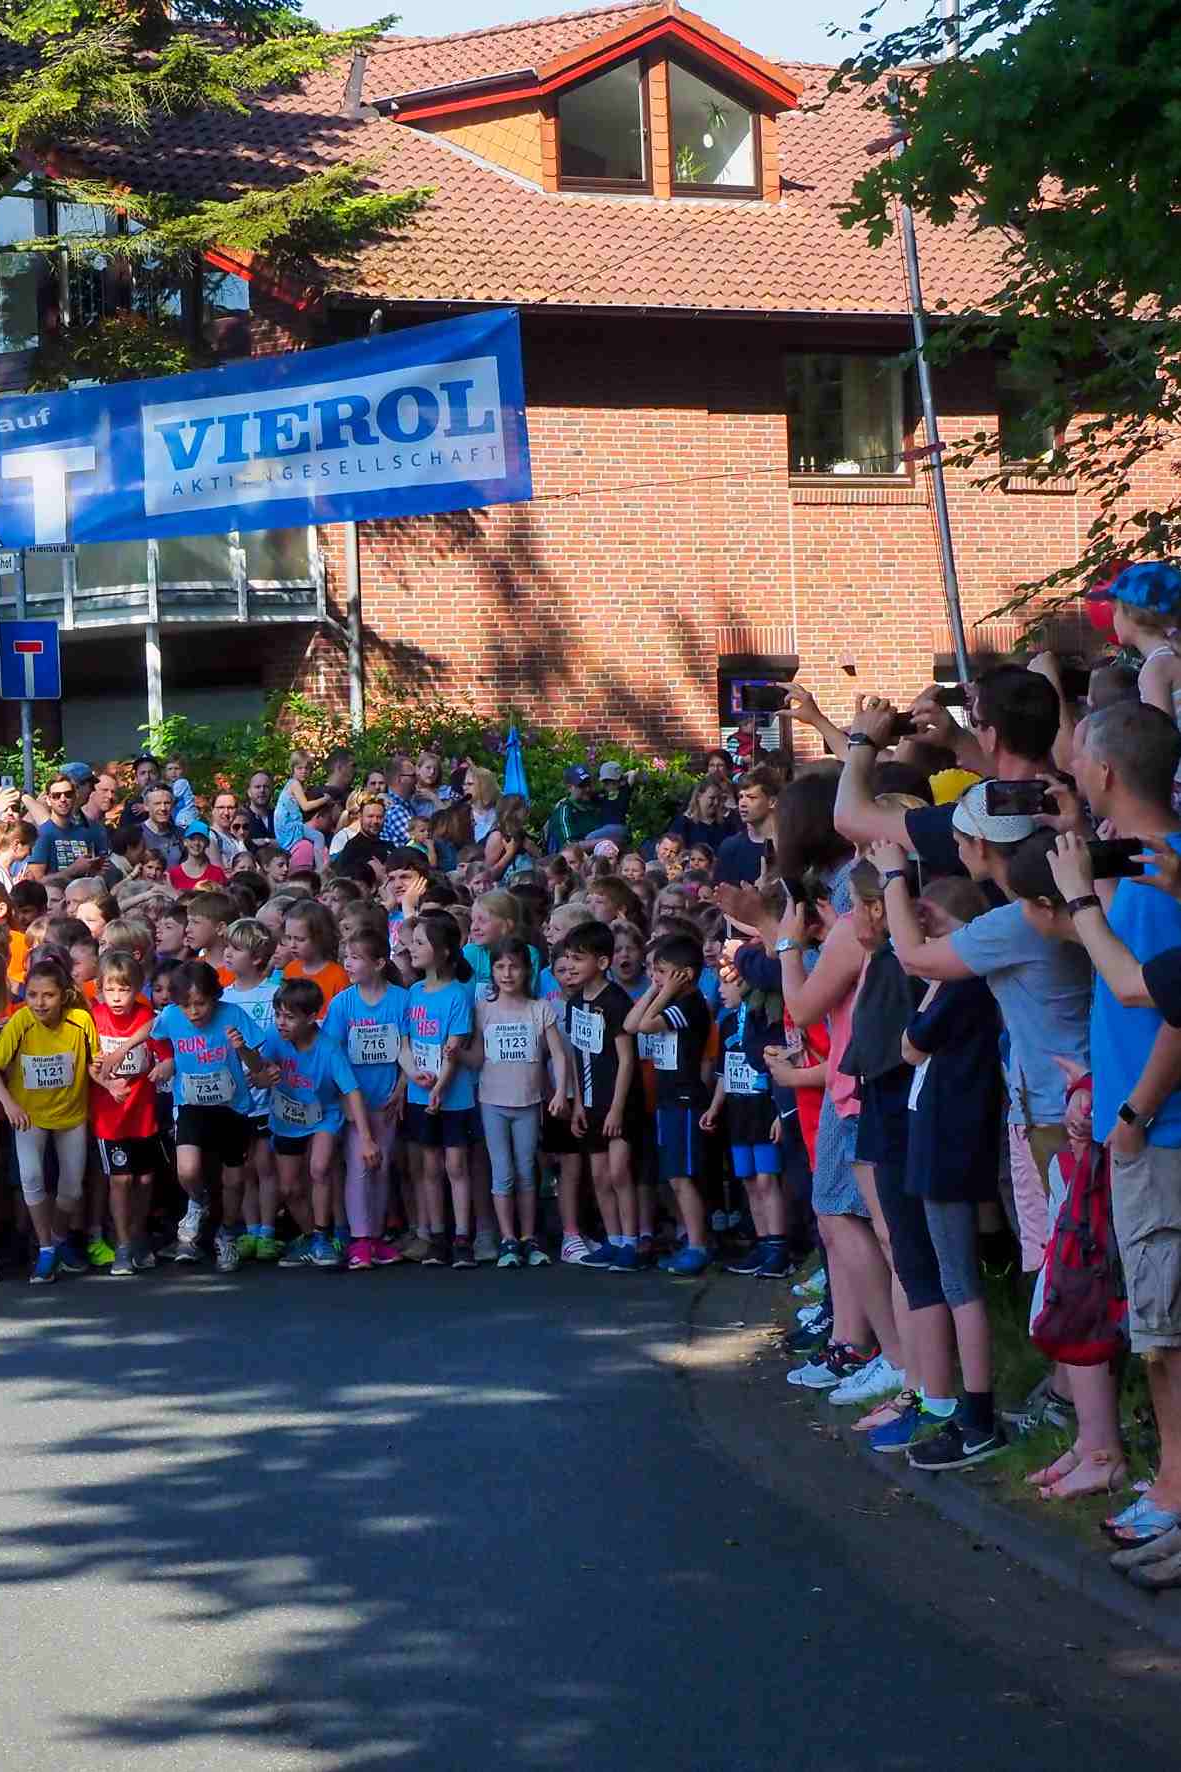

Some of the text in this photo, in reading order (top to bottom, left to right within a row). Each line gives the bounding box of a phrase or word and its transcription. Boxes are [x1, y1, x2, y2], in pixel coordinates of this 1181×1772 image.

[153, 379, 496, 472] VIEROL
[171, 444, 499, 497] AKTIENGESELLSCHAFT
[178, 1035, 206, 1053] RUN
[362, 1038, 386, 1050] 716
[499, 1037, 527, 1048] 1123
[362, 1050, 388, 1061] bruns
[500, 1049, 526, 1060] bruns
[36, 1066, 64, 1077] 1121
[38, 1078, 64, 1087] bruns
[195, 1083, 220, 1094] 734
